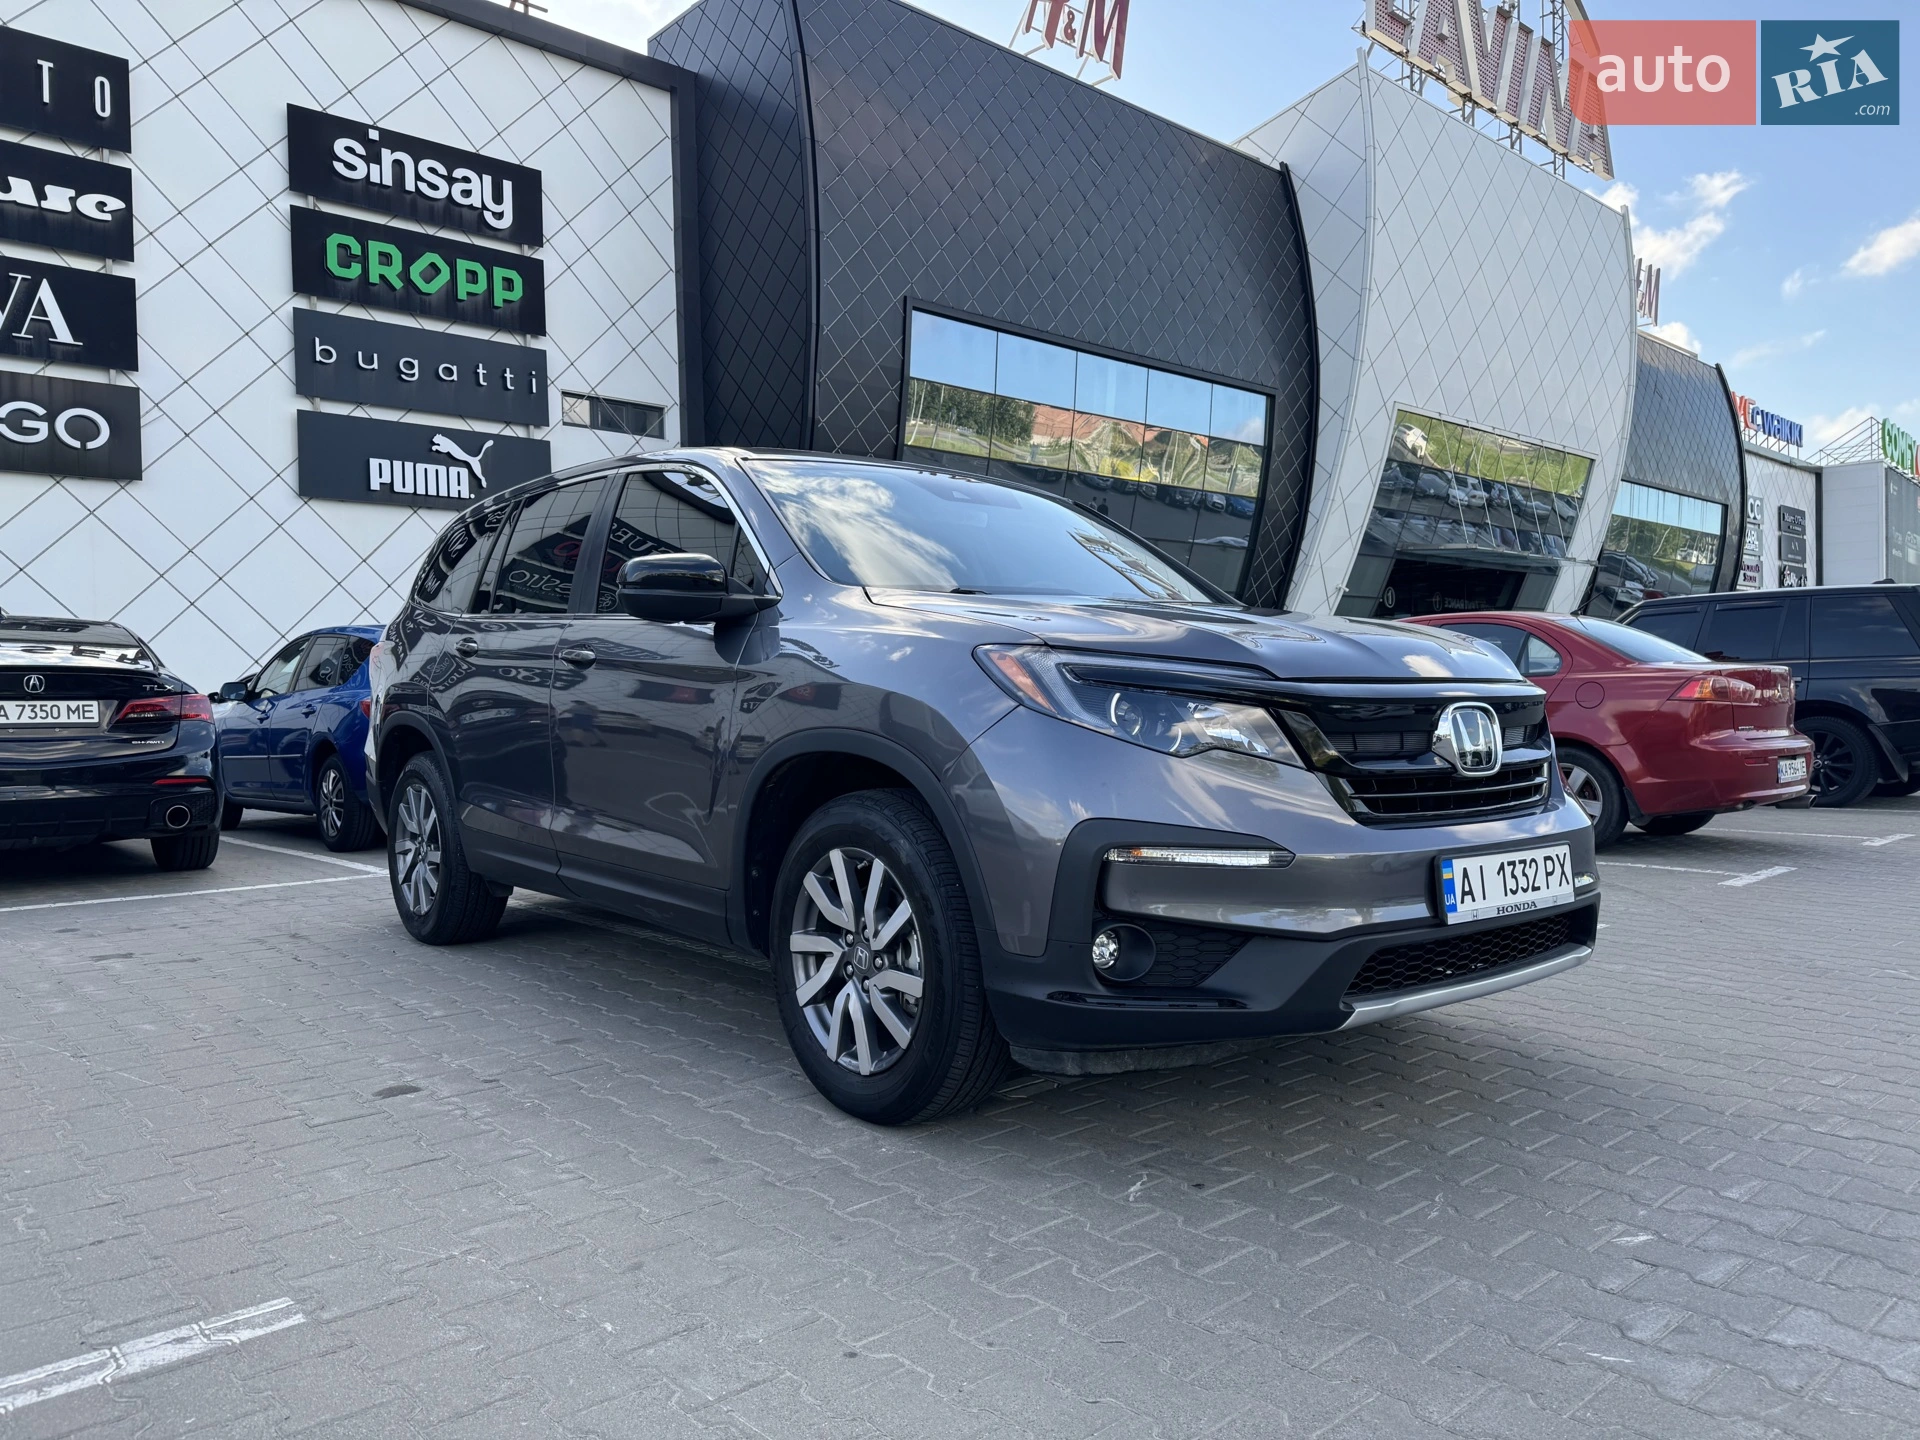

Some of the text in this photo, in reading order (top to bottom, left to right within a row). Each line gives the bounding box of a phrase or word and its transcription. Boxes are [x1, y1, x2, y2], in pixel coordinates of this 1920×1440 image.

[332, 128, 514, 229] sinsay
[324, 233, 524, 307] CROPP
[314, 336, 537, 394] bugatti
[1881, 417, 1917, 476] COMFY
[369, 457, 475, 499] PUMA
[142, 684, 175, 692] TLX
[16, 705, 61, 720] 7350
[67, 705, 95, 720] ME
[1444, 893, 1456, 906] UA
[1461, 852, 1571, 904] AI 1332 PX
[1496, 901, 1538, 916] HONDA
